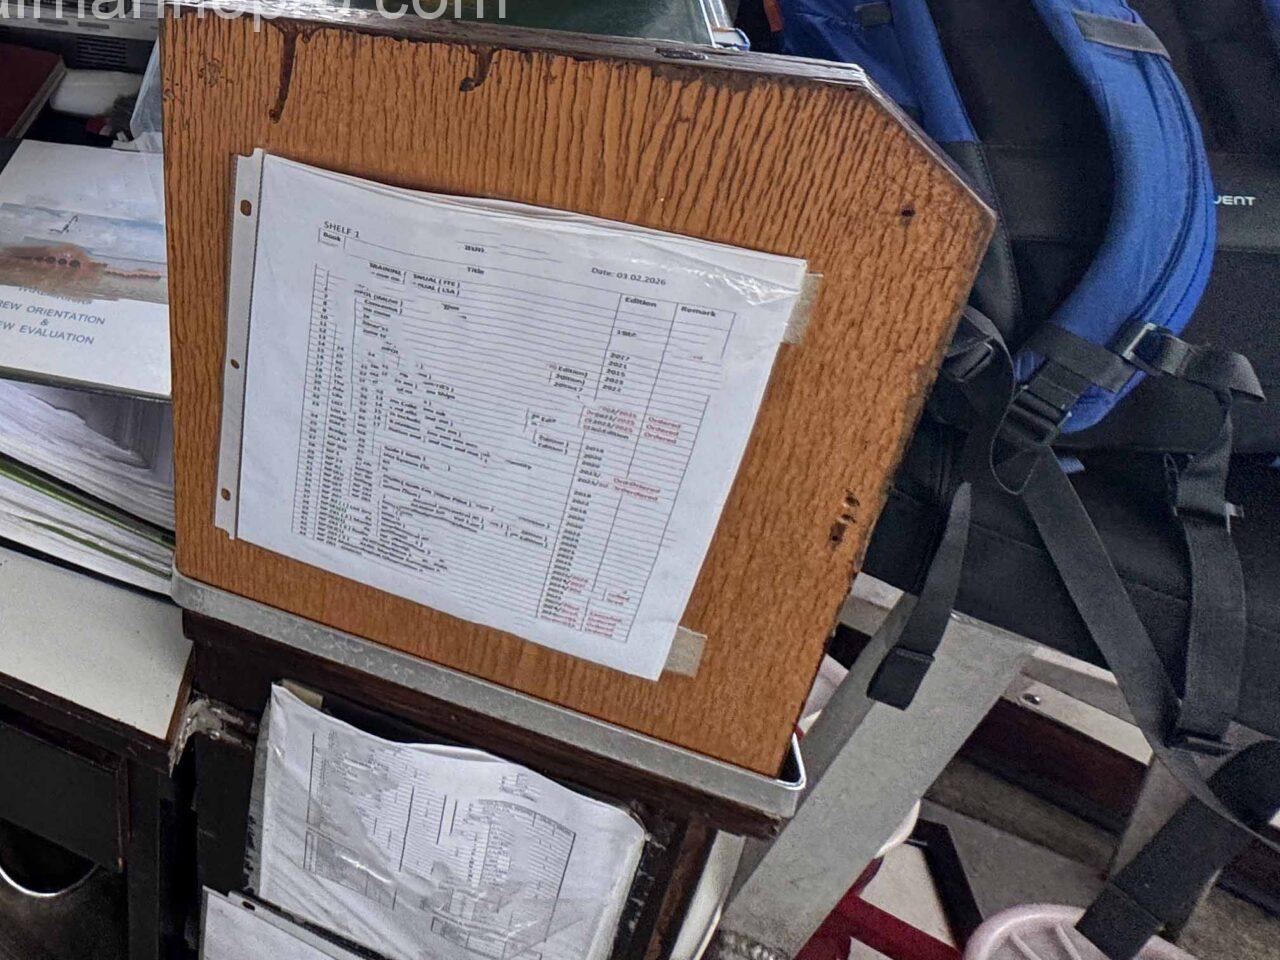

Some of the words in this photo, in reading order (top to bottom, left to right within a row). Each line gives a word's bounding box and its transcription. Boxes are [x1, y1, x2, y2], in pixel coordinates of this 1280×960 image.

[323, 221, 352, 235] SHELF
[26, 305, 106, 325] ORIENTATION
[40, 318, 49, 326] &
[19, 325, 95, 345] EVALUATION
